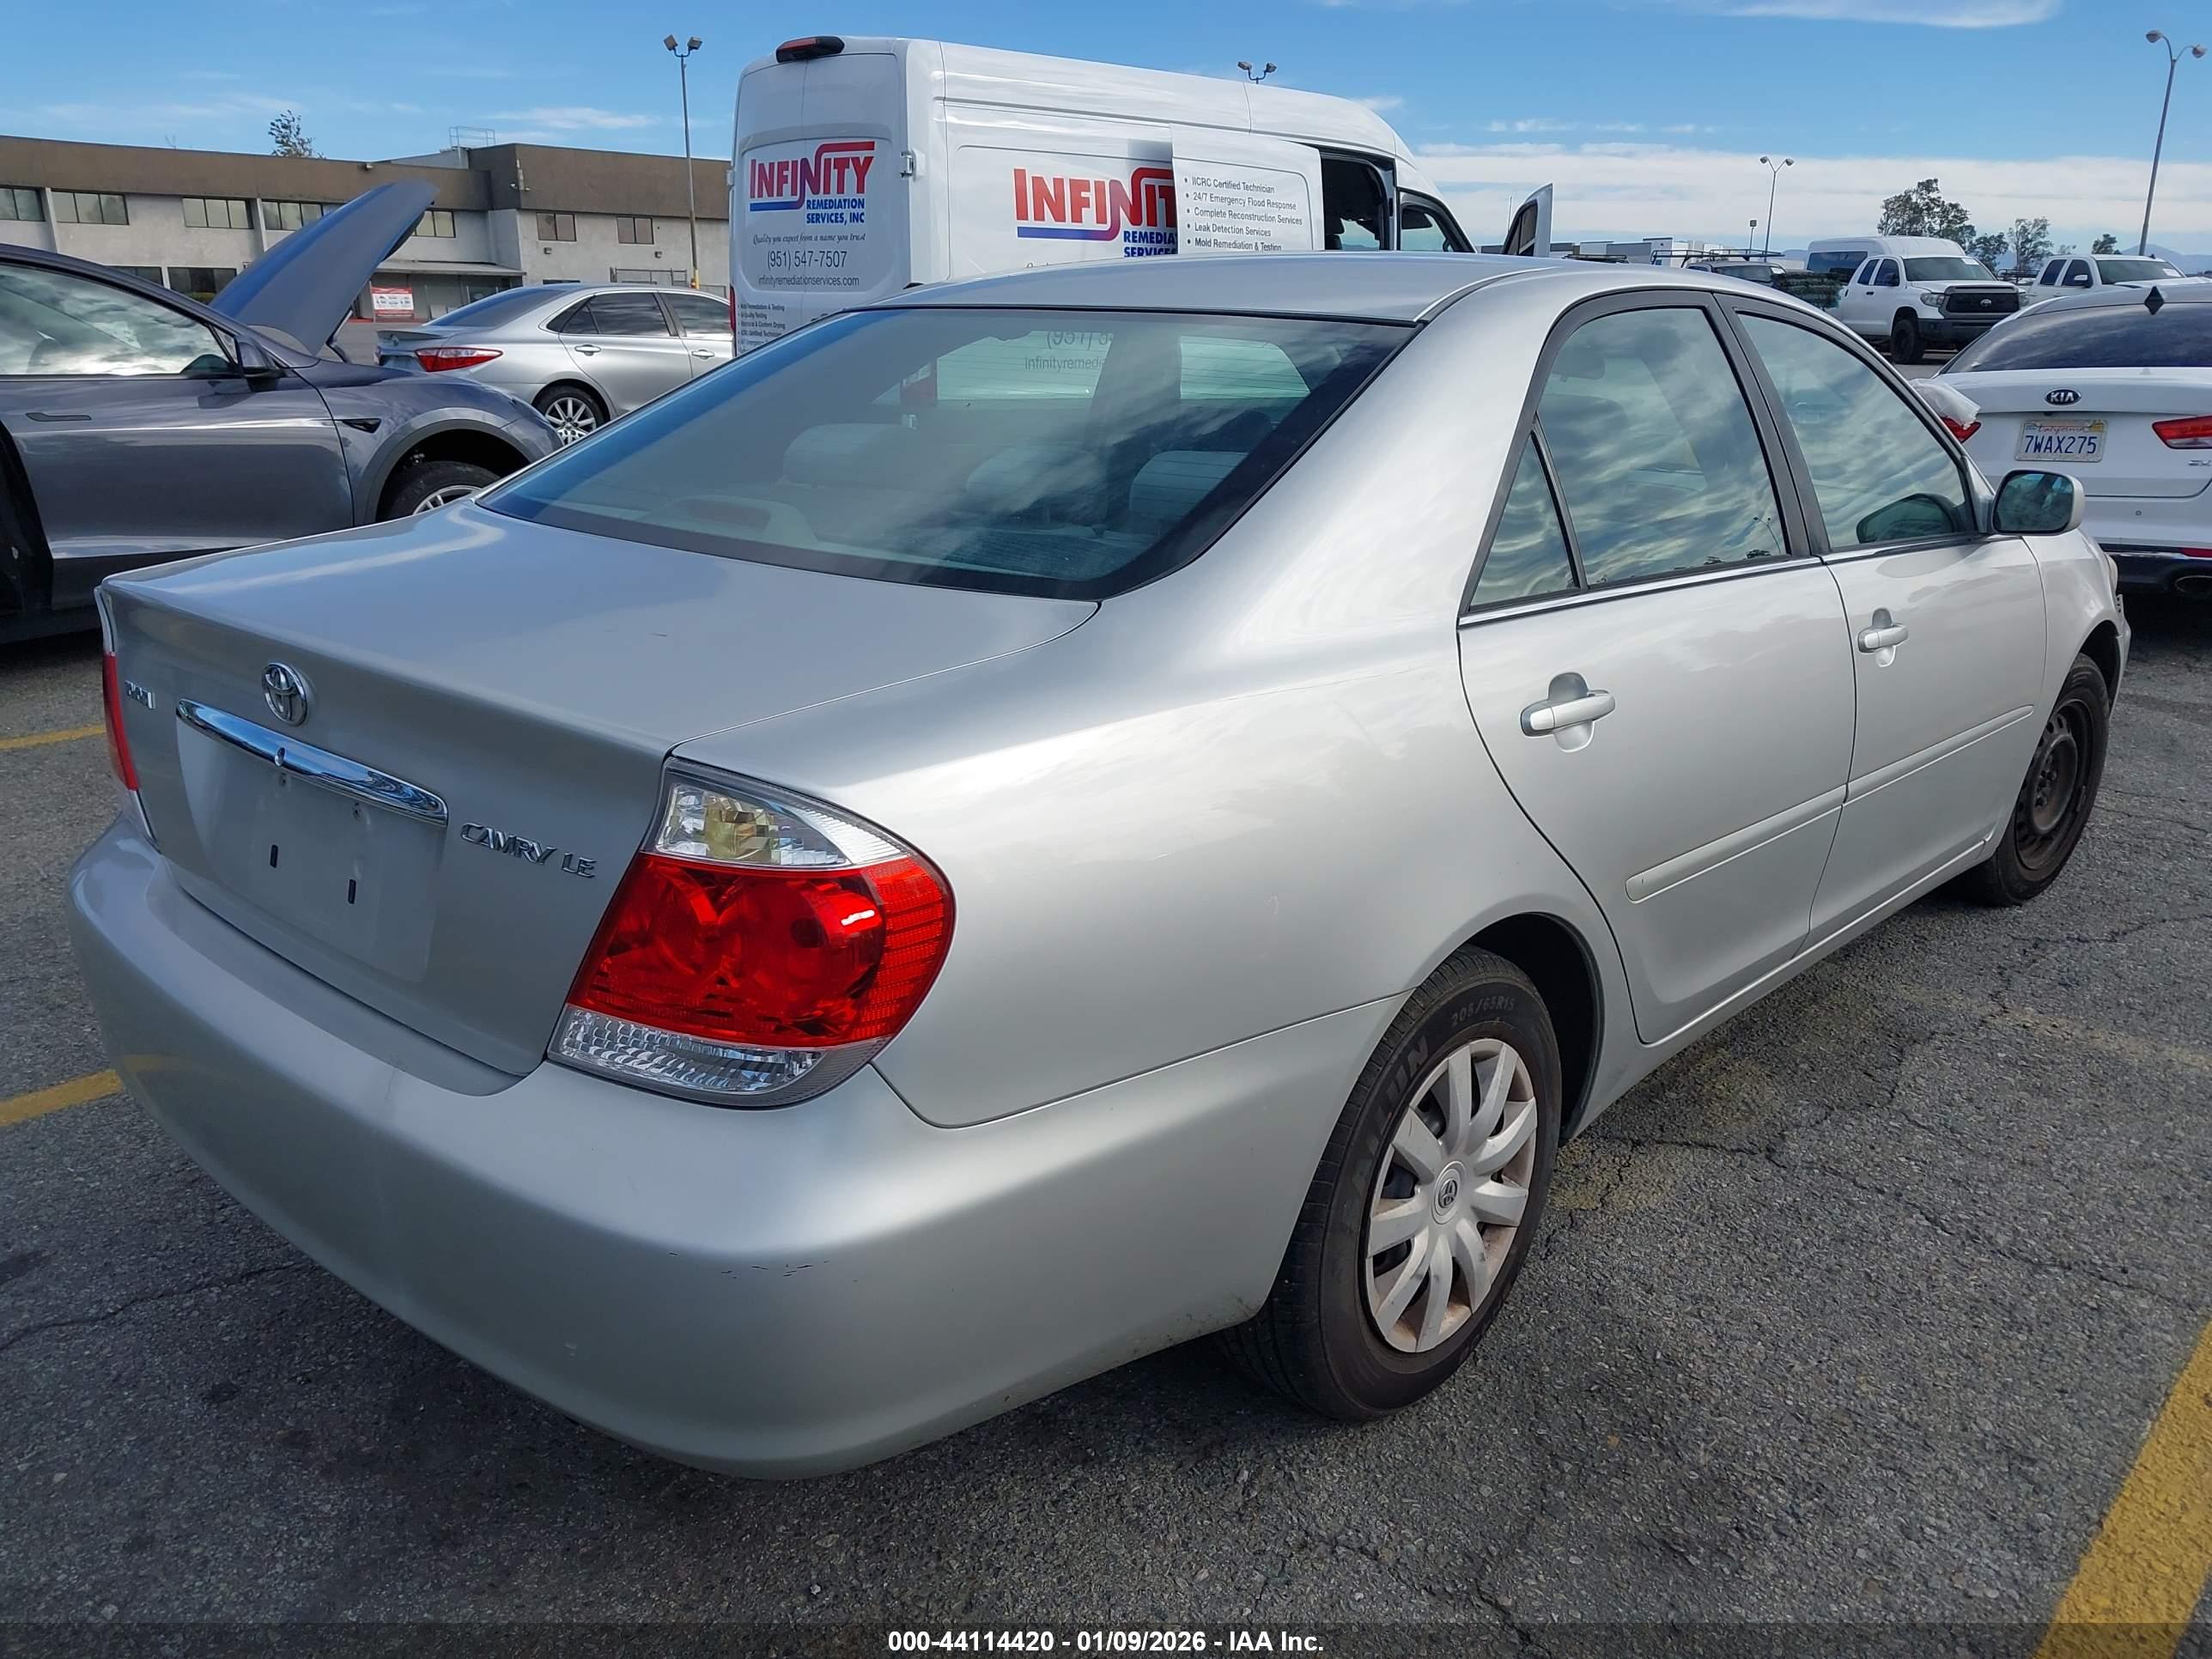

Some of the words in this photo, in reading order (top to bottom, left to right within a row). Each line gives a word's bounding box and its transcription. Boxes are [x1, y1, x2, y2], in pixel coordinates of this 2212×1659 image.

[750, 145, 875, 207] INFINITY
[1192, 176, 1212, 188] IICRC
[1212, 179, 1241, 191] Certified
[1242, 181, 1275, 195] Technician
[806, 198, 866, 210] REMEDIATION
[1193, 191, 1208, 202] 24/7
[1209, 193, 1247, 207] Emergency
[1248, 197, 1266, 207] Flood
[1267, 198, 1297, 210] Response
[806, 211, 848, 226] SERVICES,
[849, 212, 866, 223] INC
[1194, 206, 1227, 219] Complete
[1228, 210, 1277, 223] Reconstruction
[1277, 214, 1303, 226] Services
[1194, 222, 1211, 233] Leak
[1212, 223, 1244, 234] Detection
[1245, 226, 1272, 237] Services
[1194, 237, 1212, 248] Mold
[1212, 239, 1253, 251] Remediation
[1254, 241, 1259, 251] &
[768, 250, 791, 270] (951)
[794, 250, 848, 268] 547-7507
[2051, 392, 2075, 403] KIA
[2025, 434, 2098, 454] 7WAX275
[460, 822, 558, 866] CAMRY
[562, 852, 597, 879] LE
